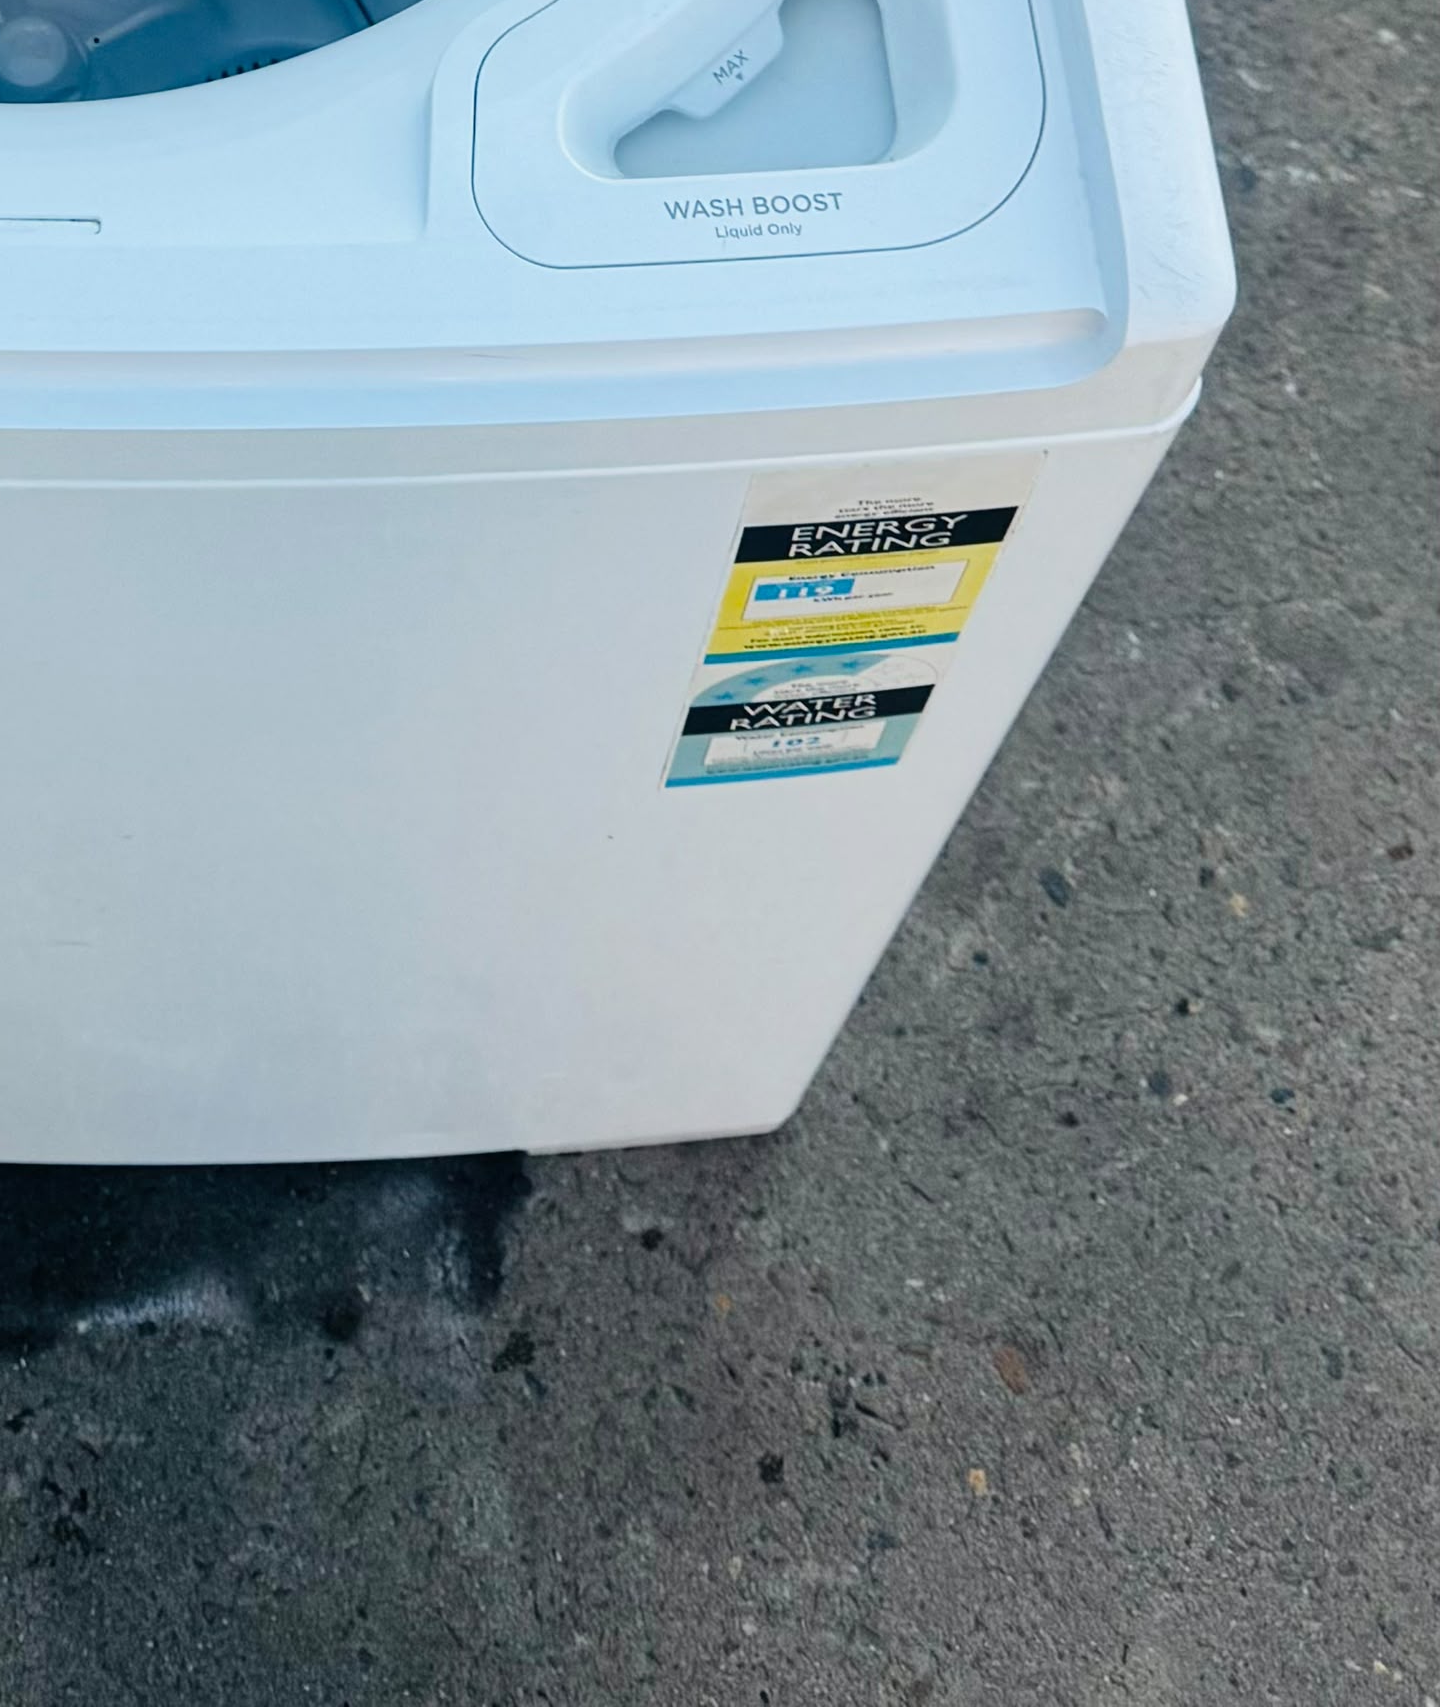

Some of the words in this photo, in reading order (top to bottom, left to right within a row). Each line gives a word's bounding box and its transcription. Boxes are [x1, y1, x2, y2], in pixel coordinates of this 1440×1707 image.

[712, 49, 749, 85] MAX
[663, 197, 744, 220] WASH
[752, 192, 843, 215] BOOST
[715, 224, 763, 239] Liquid
[767, 222, 803, 237] Only
[791, 514, 968, 541] ENERGY
[788, 534, 952, 558] RATING
[743, 694, 877, 716] WATER
[729, 707, 877, 731] RATING
